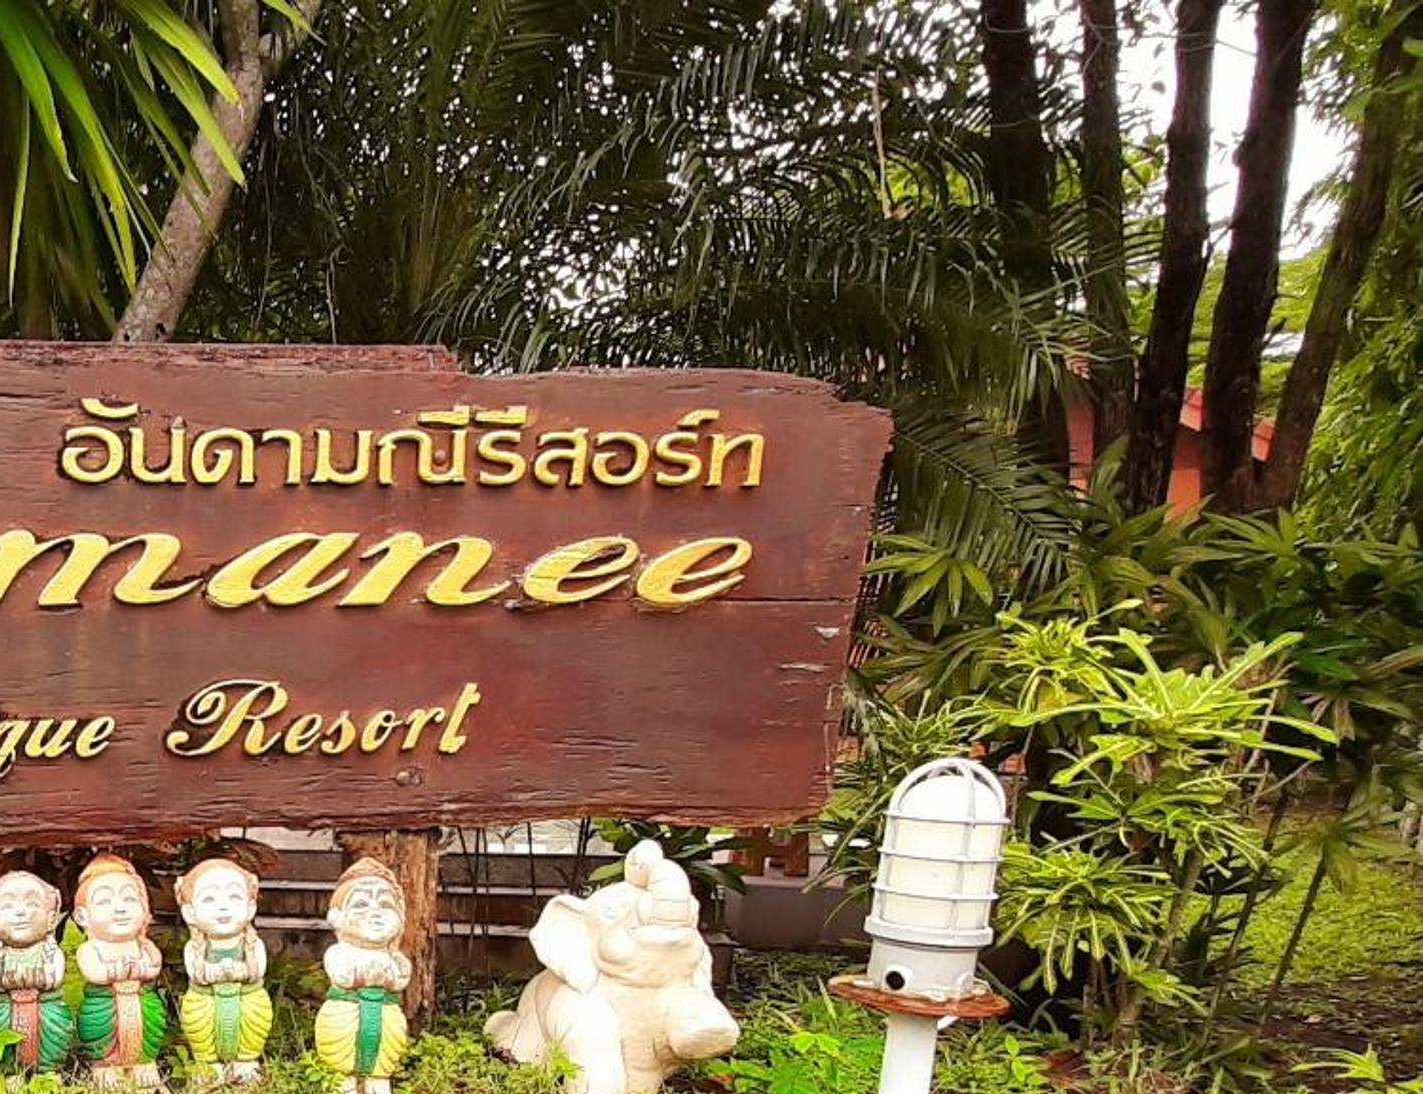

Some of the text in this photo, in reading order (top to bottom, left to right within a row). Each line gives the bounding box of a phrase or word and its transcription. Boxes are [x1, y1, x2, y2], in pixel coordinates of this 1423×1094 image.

[61, 397, 765, 488] อันดามณีรีสอร์ท
[166, 680, 482, 757] Resort
